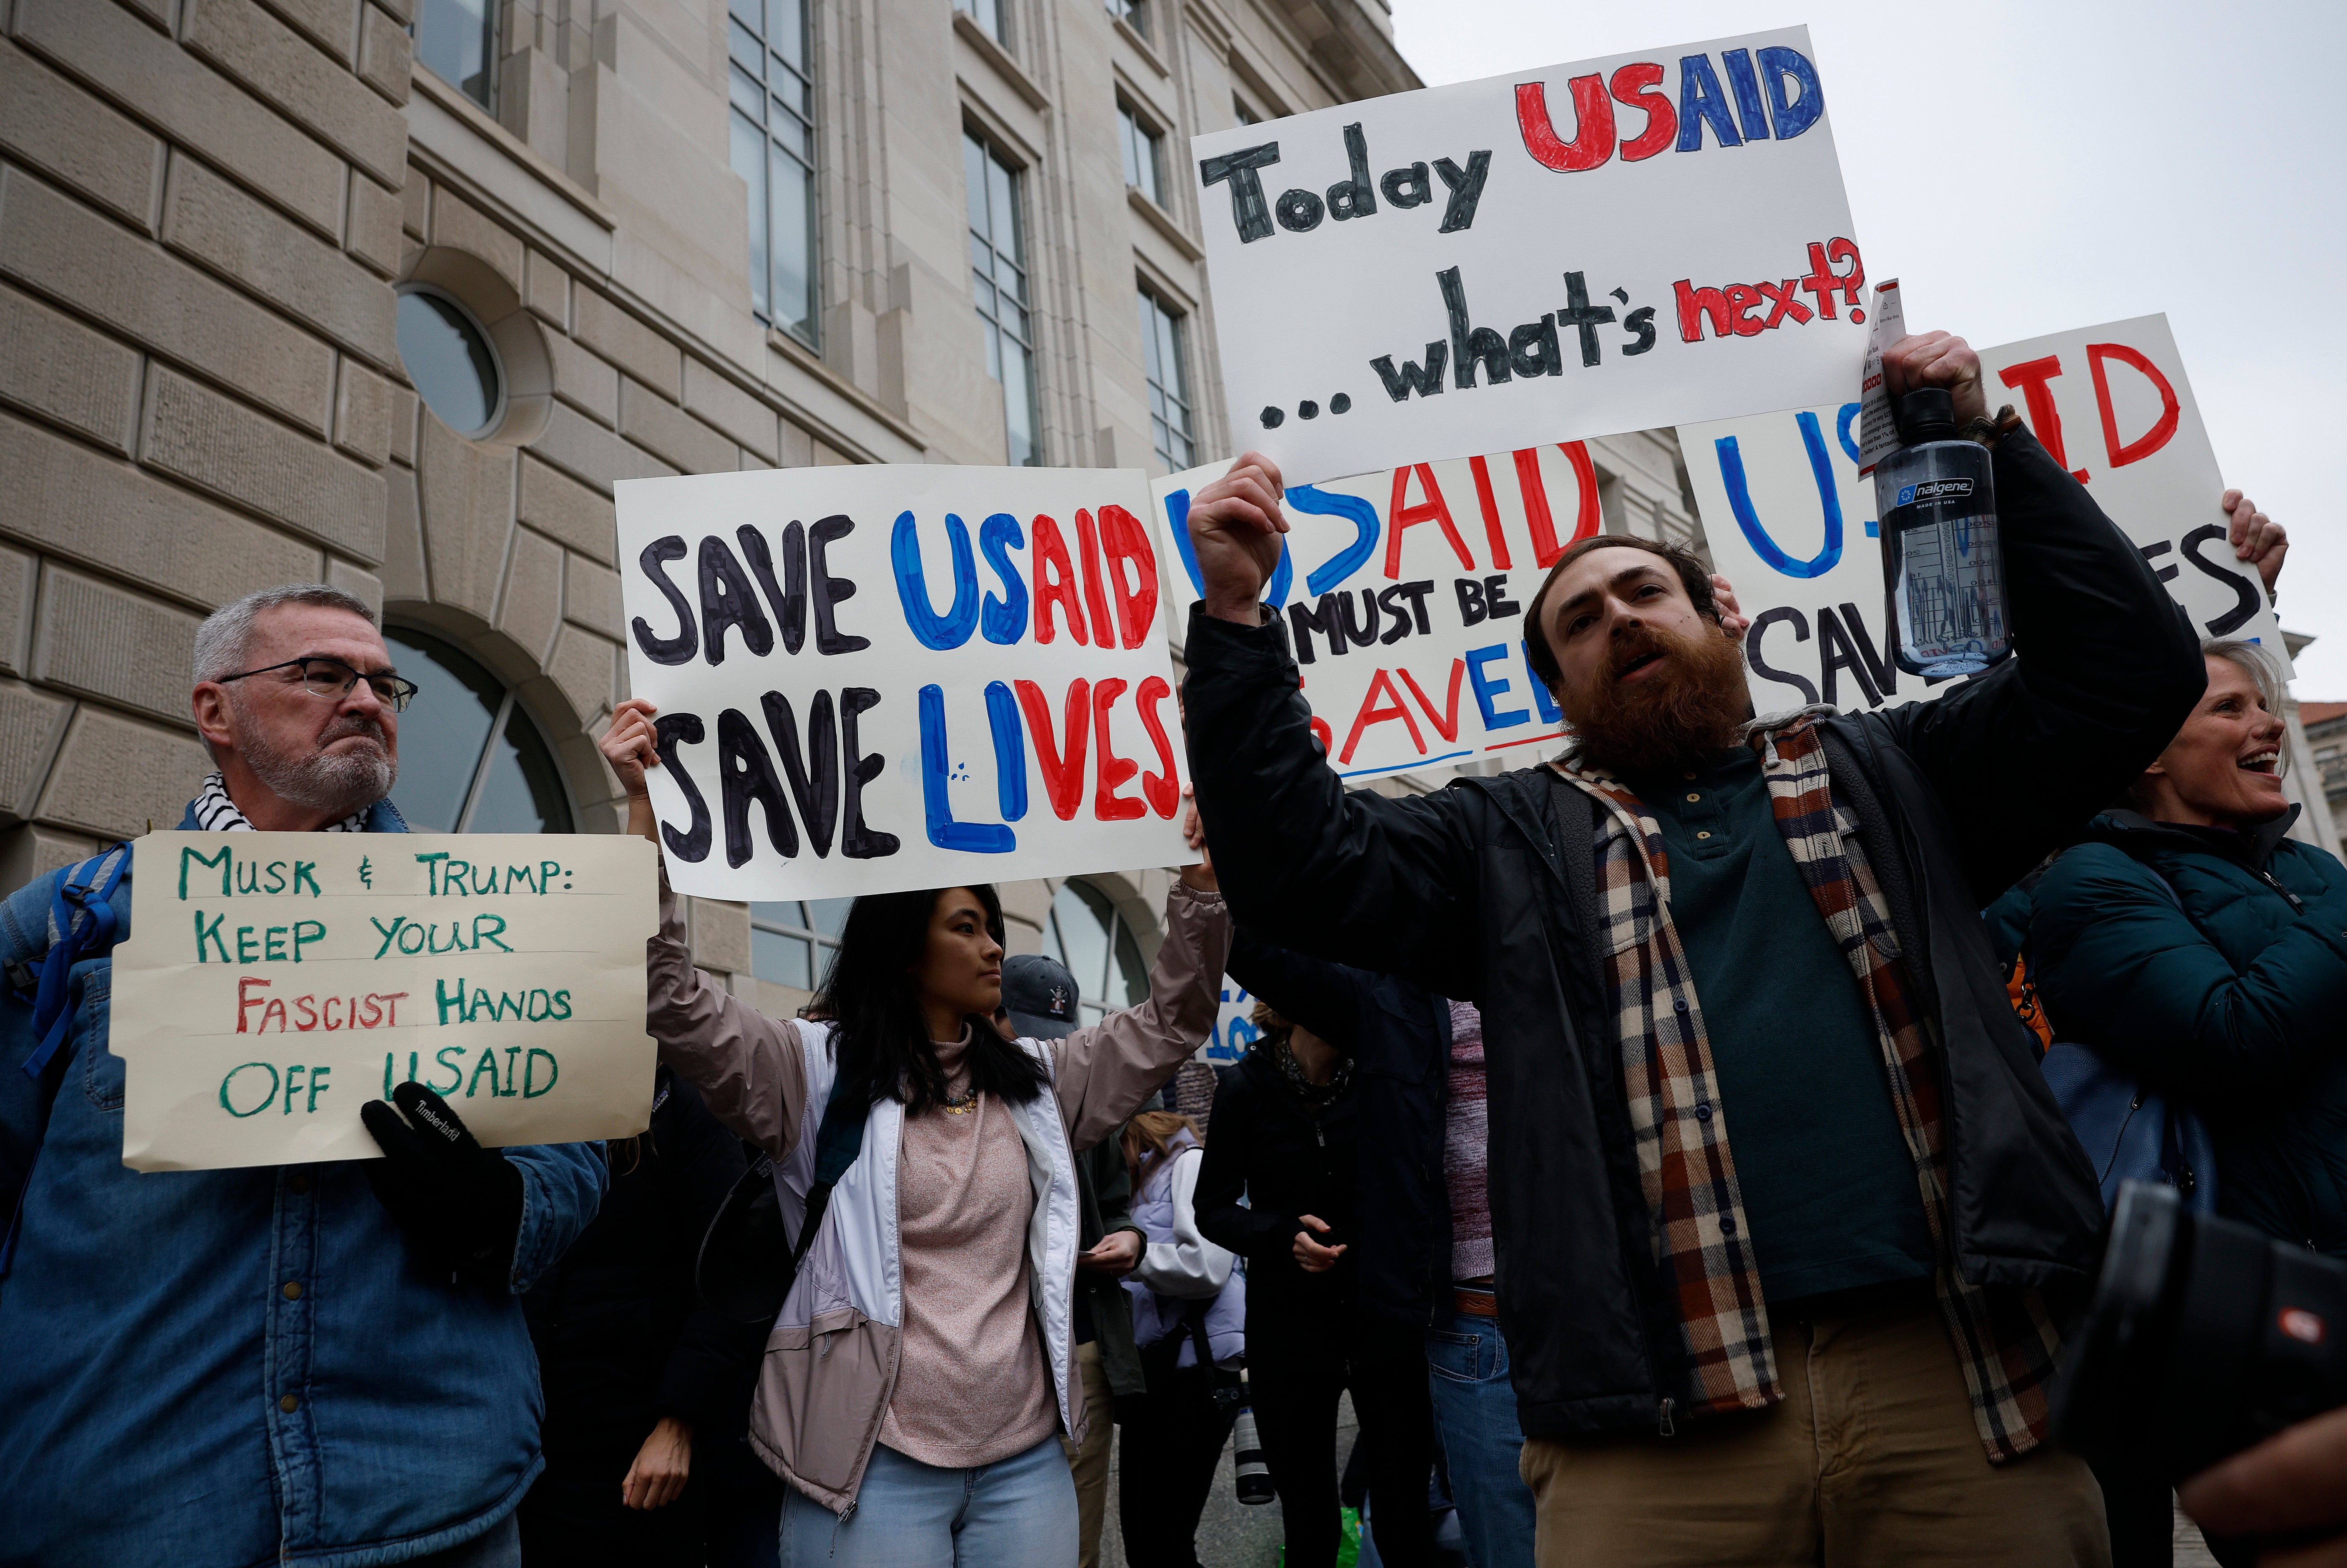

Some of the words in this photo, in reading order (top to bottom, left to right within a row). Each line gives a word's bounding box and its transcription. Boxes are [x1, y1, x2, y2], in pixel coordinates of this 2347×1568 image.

[1199, 121, 1492, 244] Today
[1514, 46, 1824, 173] USAID
[1673, 236, 1866, 344] next?
[1917, 482, 1969, 495] nalgene
[631, 514, 871, 667] SAVE
[891, 504, 1158, 651] USAID
[1288, 580, 1435, 664] MUST
[1454, 573, 1521, 627] BE
[654, 687, 901, 869] SAVE
[919, 676, 1180, 854] LIVES
[178, 846, 321, 900] MUSK
[415, 852, 573, 896] TRUMP:
[195, 910, 327, 964] KEEP
[370, 913, 513, 960] YOUR
[236, 977, 409, 1035] FASCIST
[436, 978, 572, 1025] HANDS
[219, 1063, 331, 1118] OFF
[384, 1045, 558, 1102] USAID
[415, 1100, 460, 1141] Timberland
